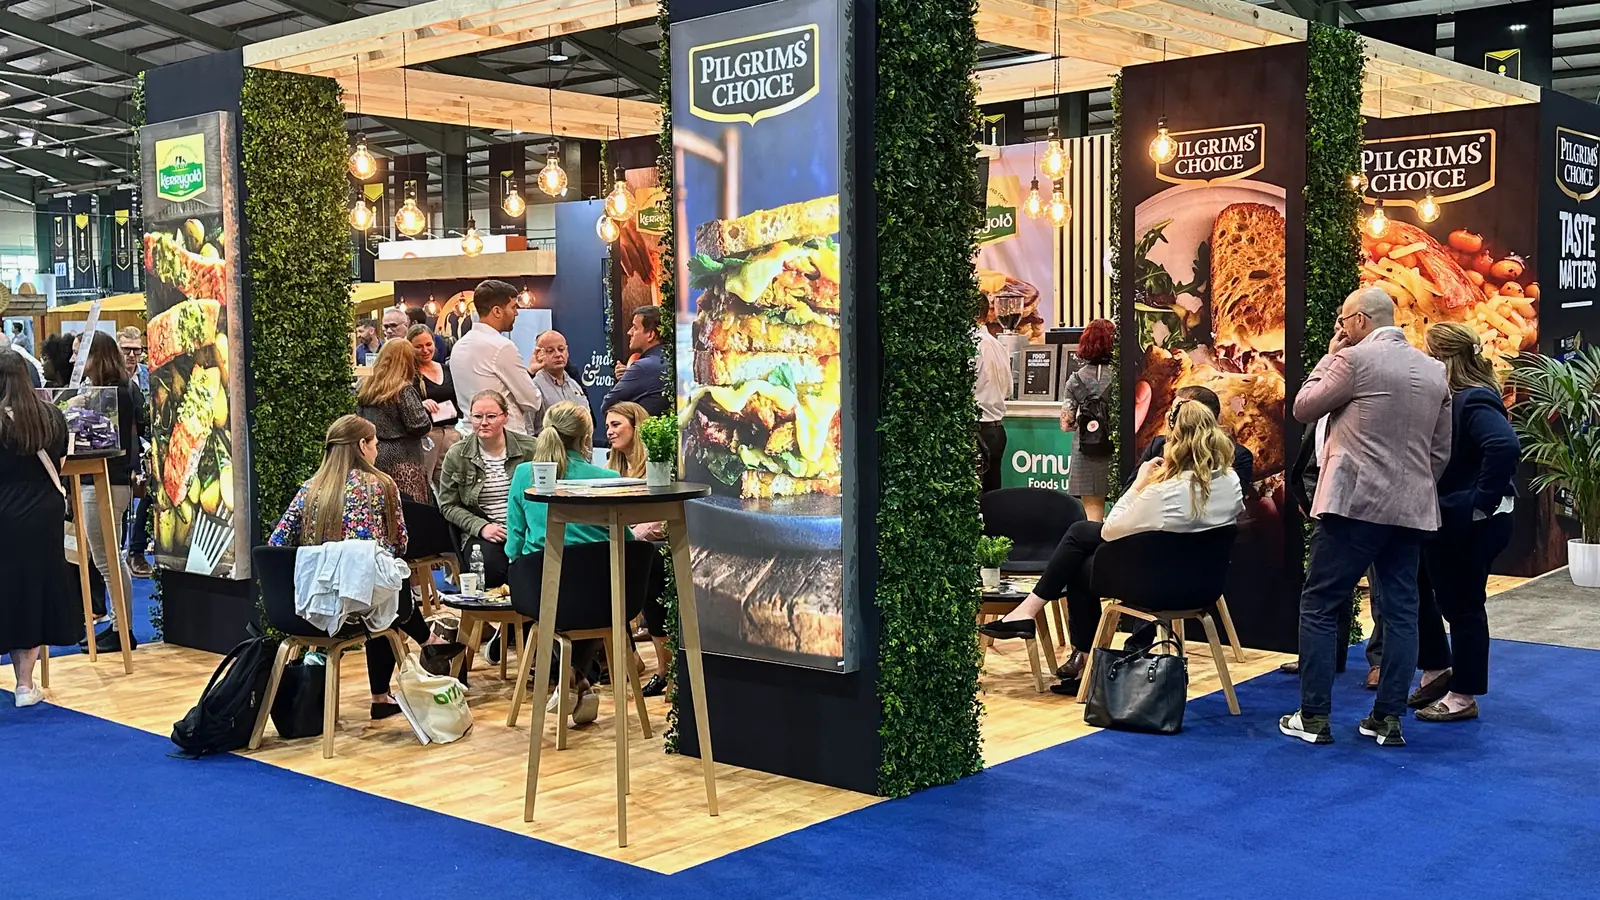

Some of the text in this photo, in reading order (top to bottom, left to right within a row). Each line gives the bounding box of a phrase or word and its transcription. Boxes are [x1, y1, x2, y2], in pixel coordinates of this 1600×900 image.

[712, 73, 795, 107] CHOICE
[1177, 133, 1255, 158] ILGRIMS
[1174, 154, 1244, 174] CHOICE
[1564, 164, 1594, 187] CHOICE
[1370, 168, 1466, 193] CHOICE
[1559, 210, 1596, 259] TASTE
[1559, 258, 1597, 290] MATTERS
[1011, 450, 1072, 475] Ornu
[1028, 477, 1069, 490] Foods U
